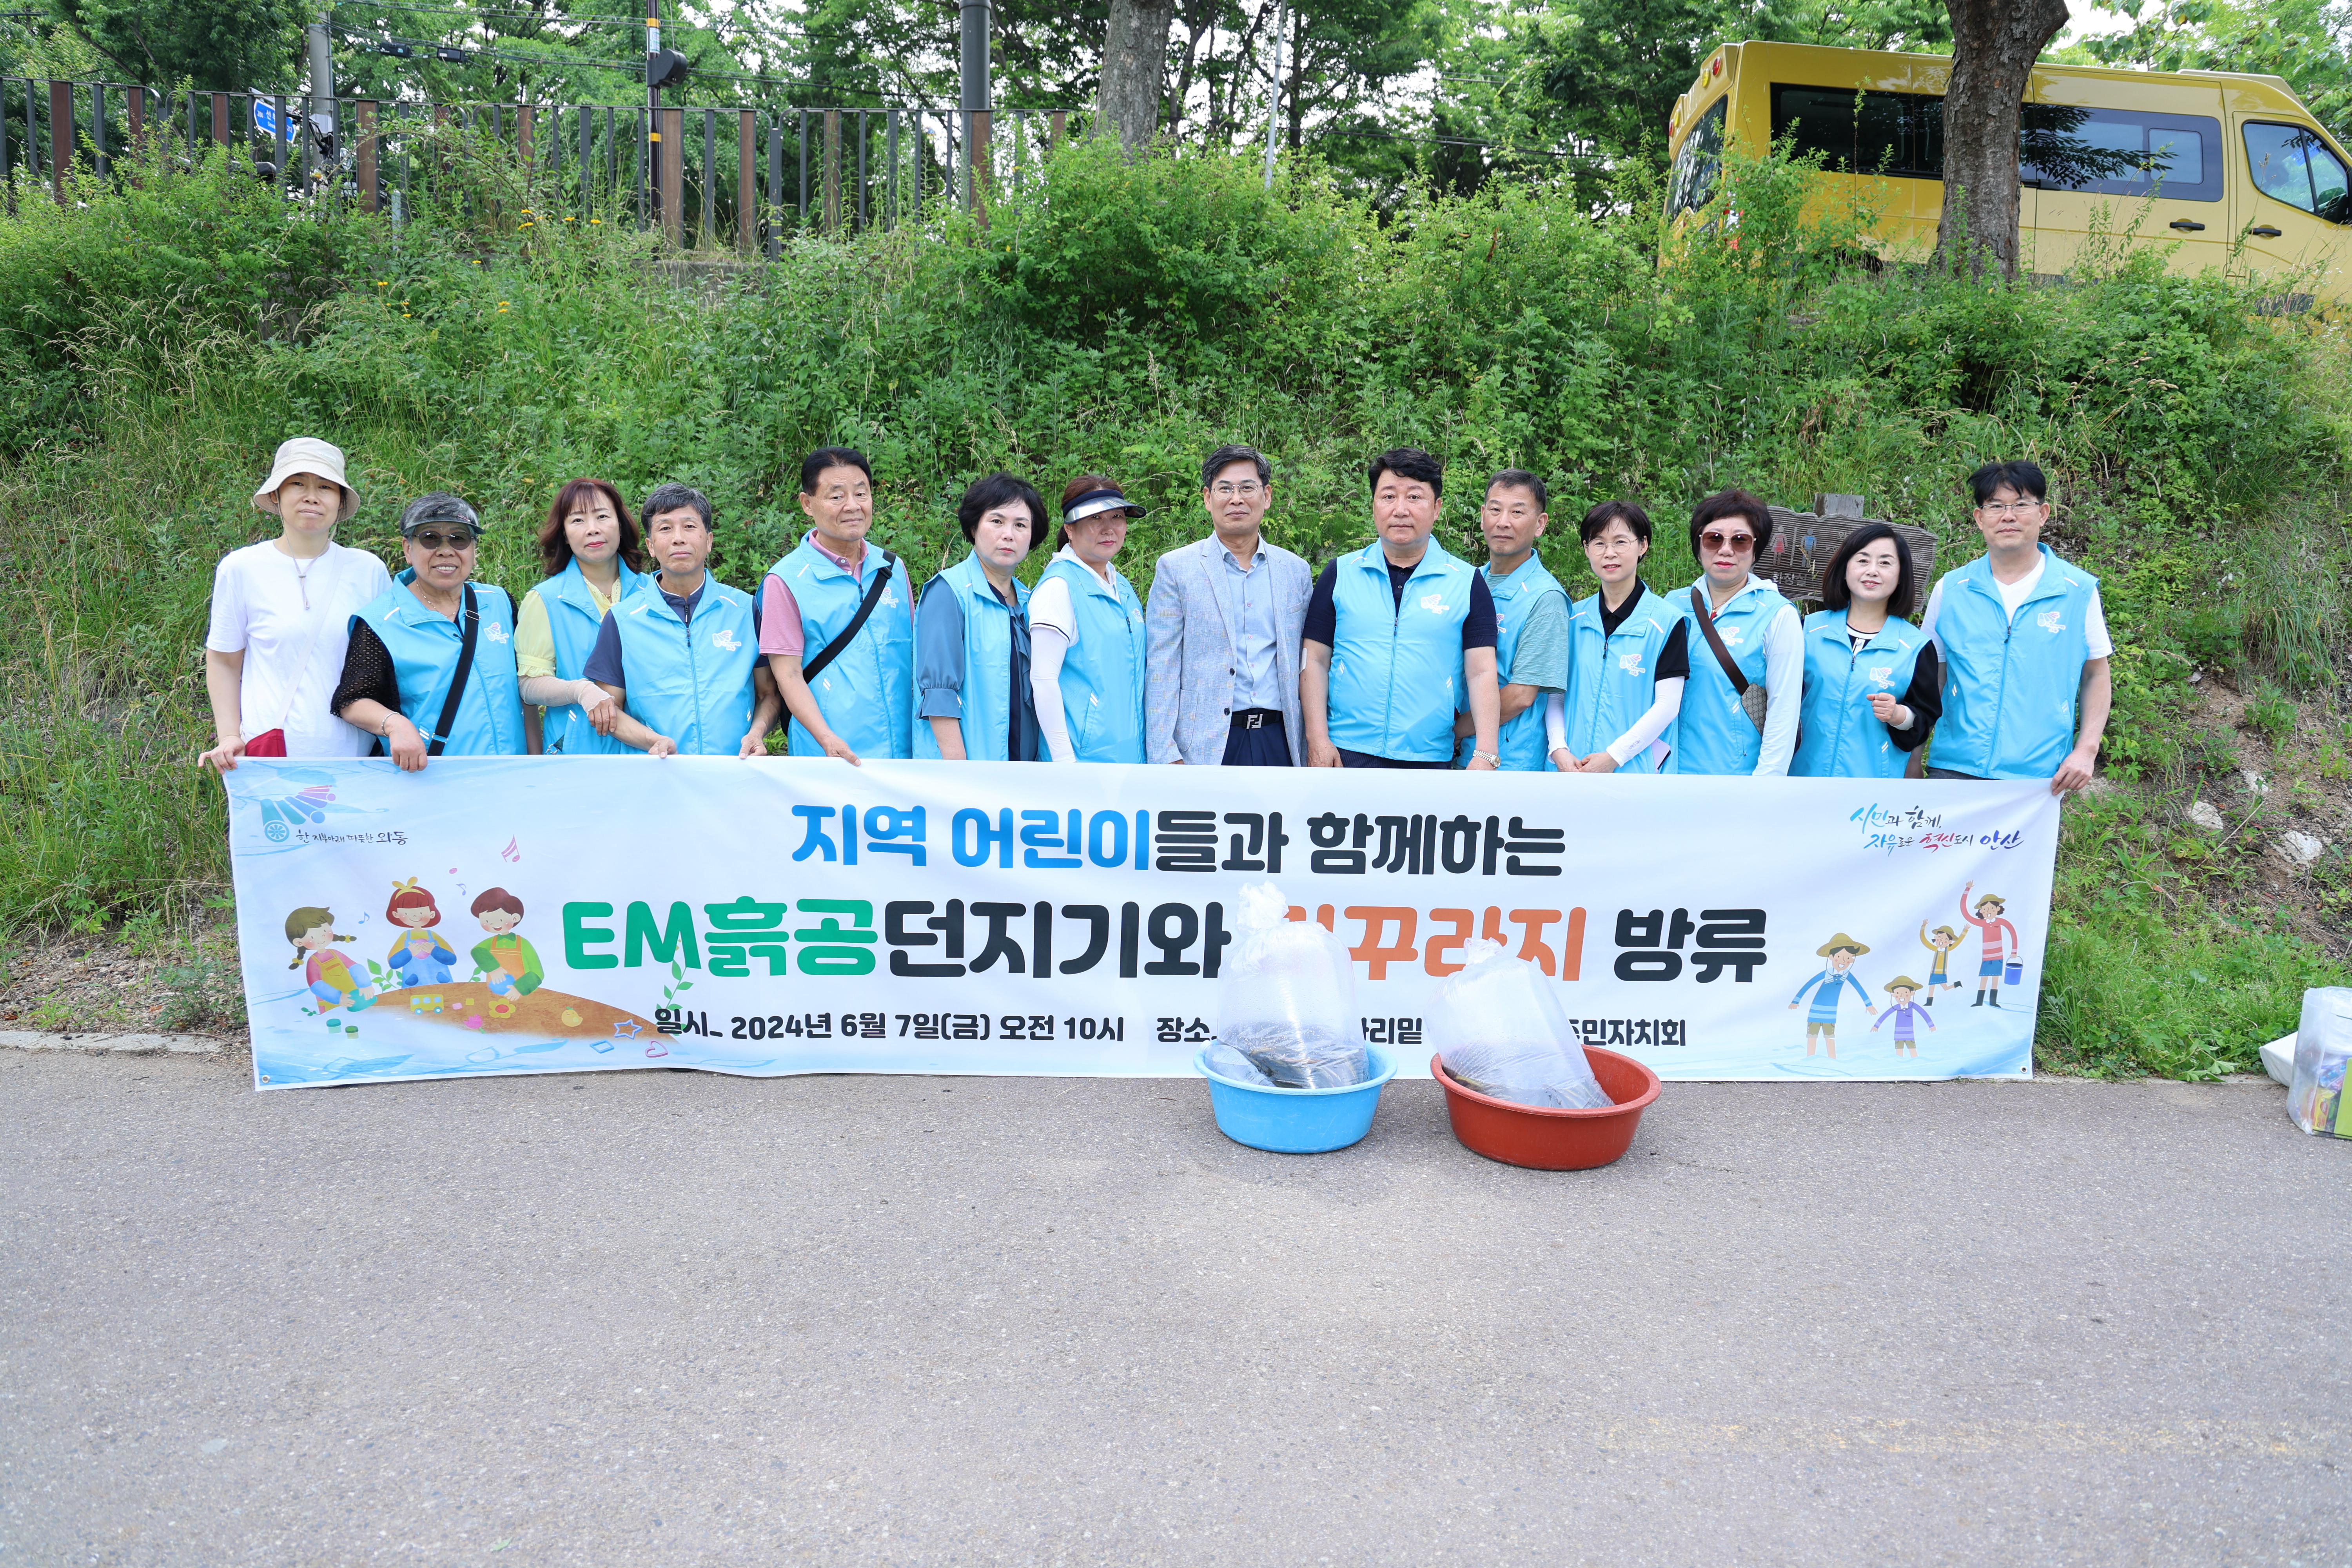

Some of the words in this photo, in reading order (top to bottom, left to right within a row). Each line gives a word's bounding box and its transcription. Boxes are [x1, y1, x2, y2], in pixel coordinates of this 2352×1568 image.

[1771, 571, 1807, 586] 화장실
[1850, 803, 1904, 834] 시민과
[296, 829, 310, 843] 한
[312, 832, 345, 843] 지붕아래
[346, 832, 374, 843] 따뜻한
[376, 831, 408, 845] 와동
[791, 804, 927, 867] 지역
[952, 807, 1289, 873] 어린이들과
[1307, 812, 1566, 876] 함께하는
[1864, 833, 1915, 857] 자유로운
[1918, 832, 1974, 853] 혁신도시
[1980, 830, 2025, 850] 안산
[562, 896, 1232, 978] EM흙공던지기와
[1283, 902, 1587, 981] 꾸라지
[1614, 907, 1767, 984] 방류
[731, 1012, 832, 1040] 2024년
[841, 1013, 886, 1038] 6월
[895, 1013, 990, 1041] 7일(금)
[999, 1015, 1054, 1041] 오전
[1063, 1016, 1124, 1042] 10시
